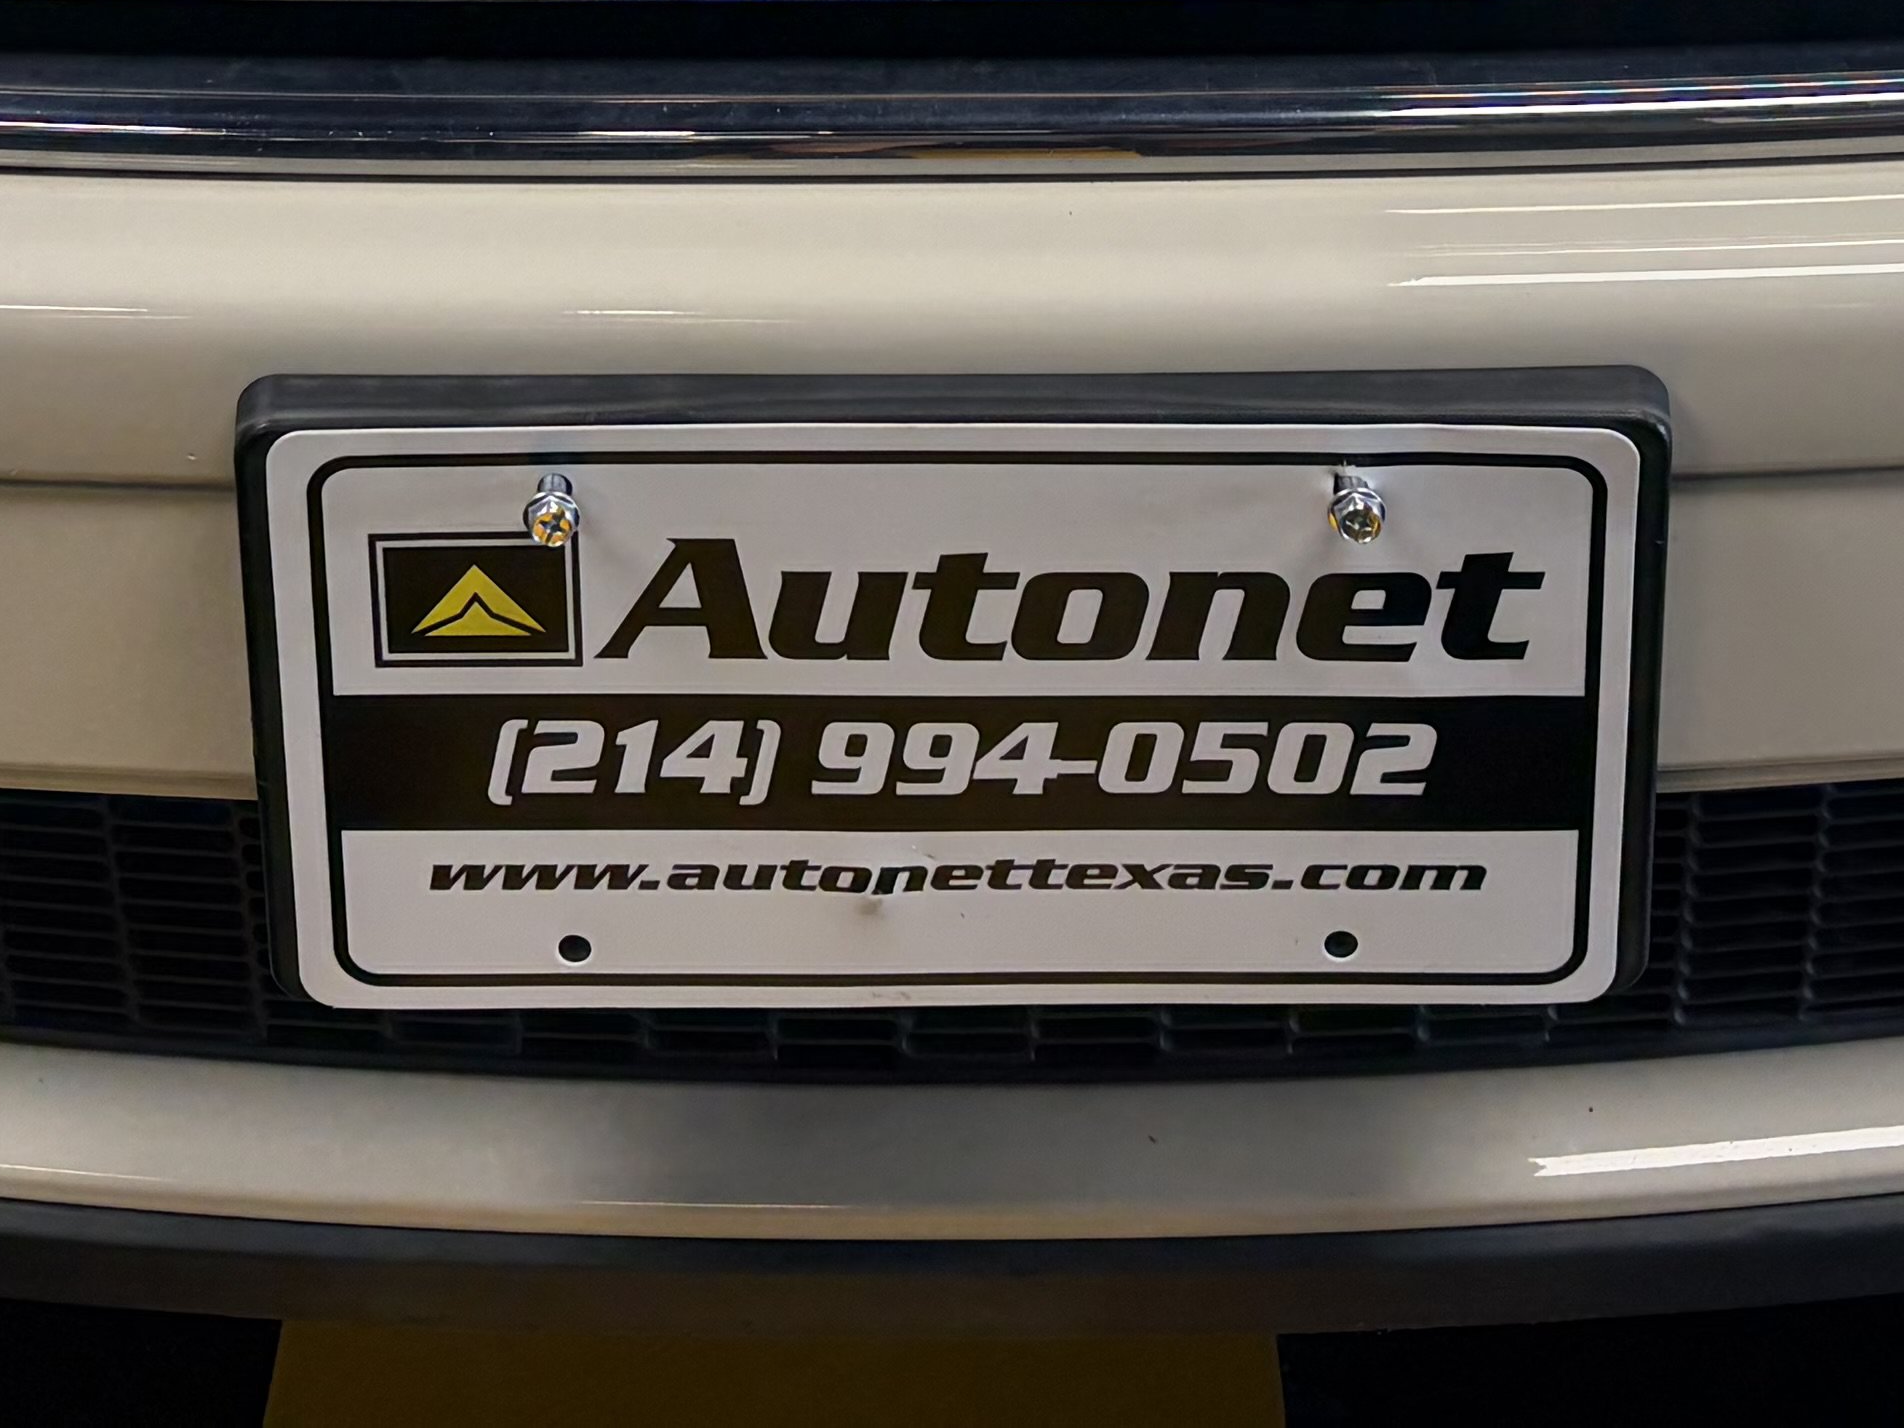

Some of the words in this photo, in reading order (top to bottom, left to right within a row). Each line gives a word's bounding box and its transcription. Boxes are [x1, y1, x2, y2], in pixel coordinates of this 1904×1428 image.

[593, 537, 1546, 663] Autonet
[487, 719, 781, 806] (214)
[811, 720, 1438, 797] 994-0502
[429, 858, 1488, 895] www.autonettexas.com
